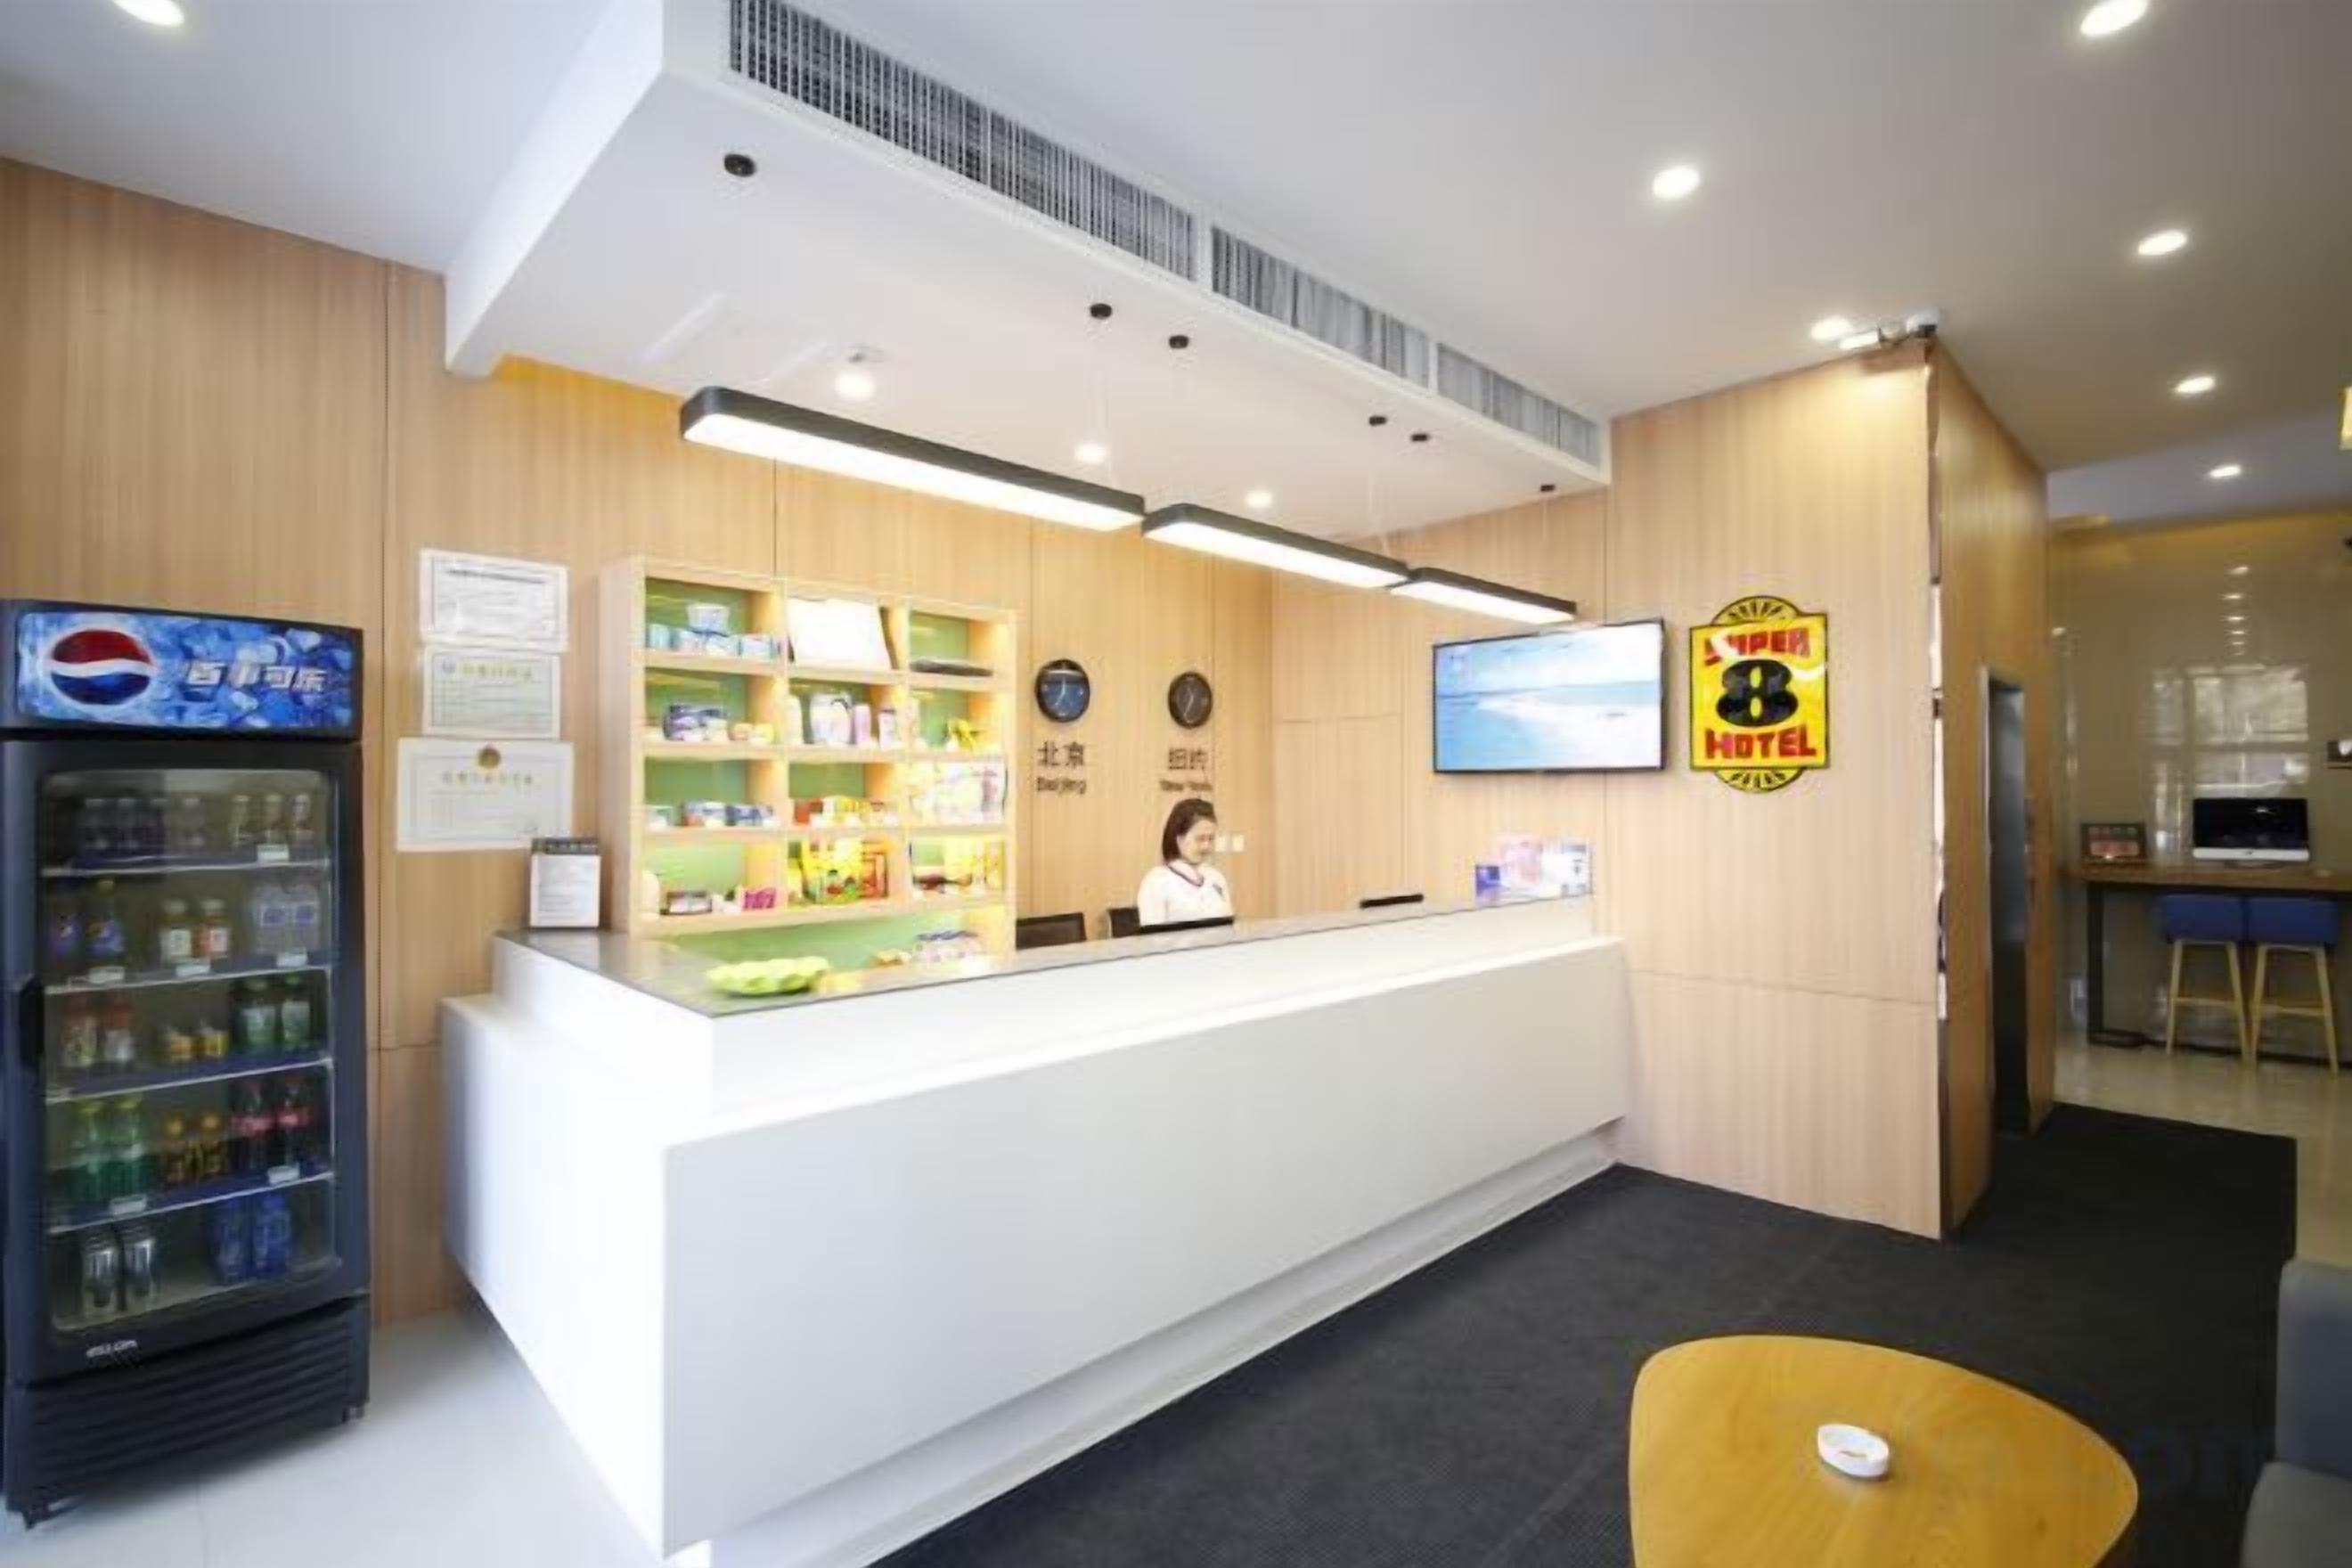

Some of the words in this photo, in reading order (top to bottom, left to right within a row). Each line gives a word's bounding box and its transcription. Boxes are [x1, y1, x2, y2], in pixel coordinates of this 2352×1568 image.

[1716, 658, 1799, 727] 8
[1037, 740, 1085, 769] 北京
[1703, 723, 1817, 759] HOTEL
